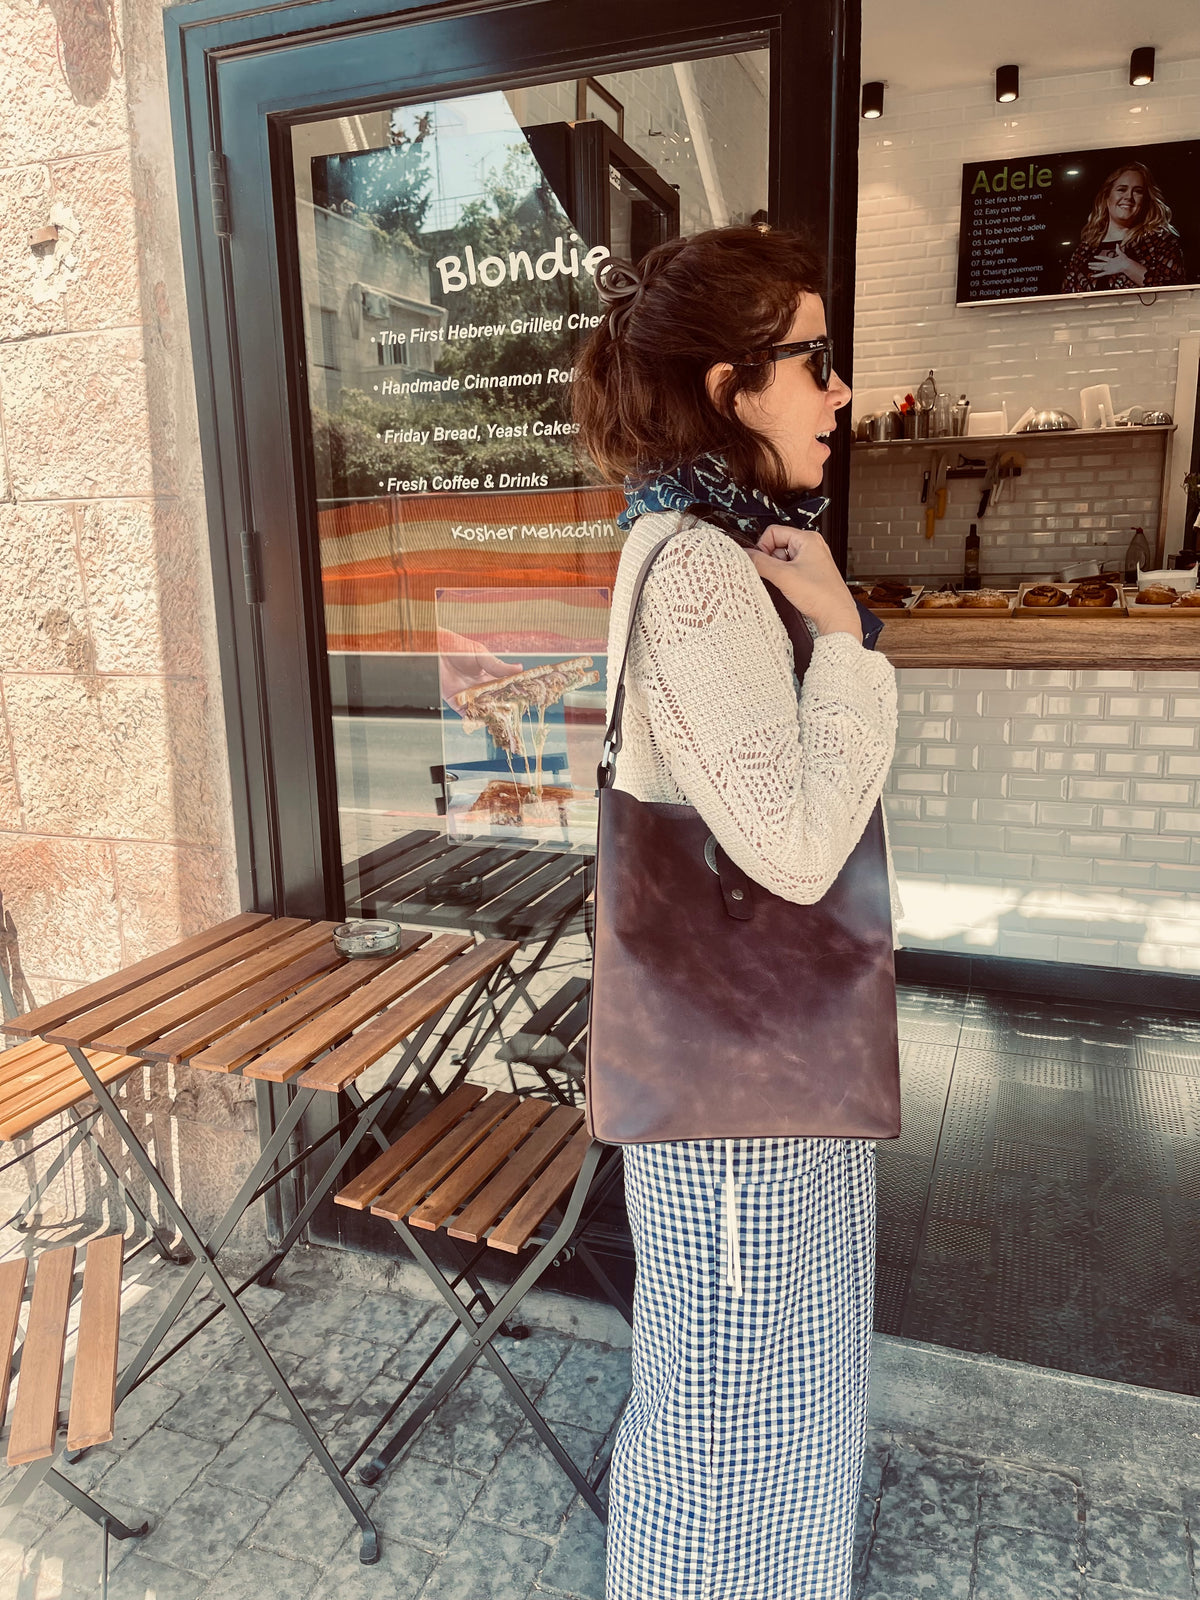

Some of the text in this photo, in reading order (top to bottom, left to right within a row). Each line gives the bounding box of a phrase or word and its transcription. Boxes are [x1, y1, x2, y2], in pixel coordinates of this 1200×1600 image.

[971, 164, 1053, 194] Adele
[435, 233, 611, 294] Blondie
[984, 248, 1004, 256] Skyfall
[982, 278, 1012, 286] Someone
[983, 268, 1008, 276] Chasing
[1008, 265, 1044, 274] pavements
[379, 328, 406, 346] The
[410, 326, 444, 343] First
[448, 322, 506, 340] Hebrew
[510, 315, 563, 335] Grilled
[382, 367, 577, 395] Handmade Cinnamon Rol
[384, 421, 580, 445] Friday Bread, Yeast Cakes
[387, 473, 549, 492] Fresh Coffee & Drinks
[451, 520, 614, 543] Kosher Mehadrin
